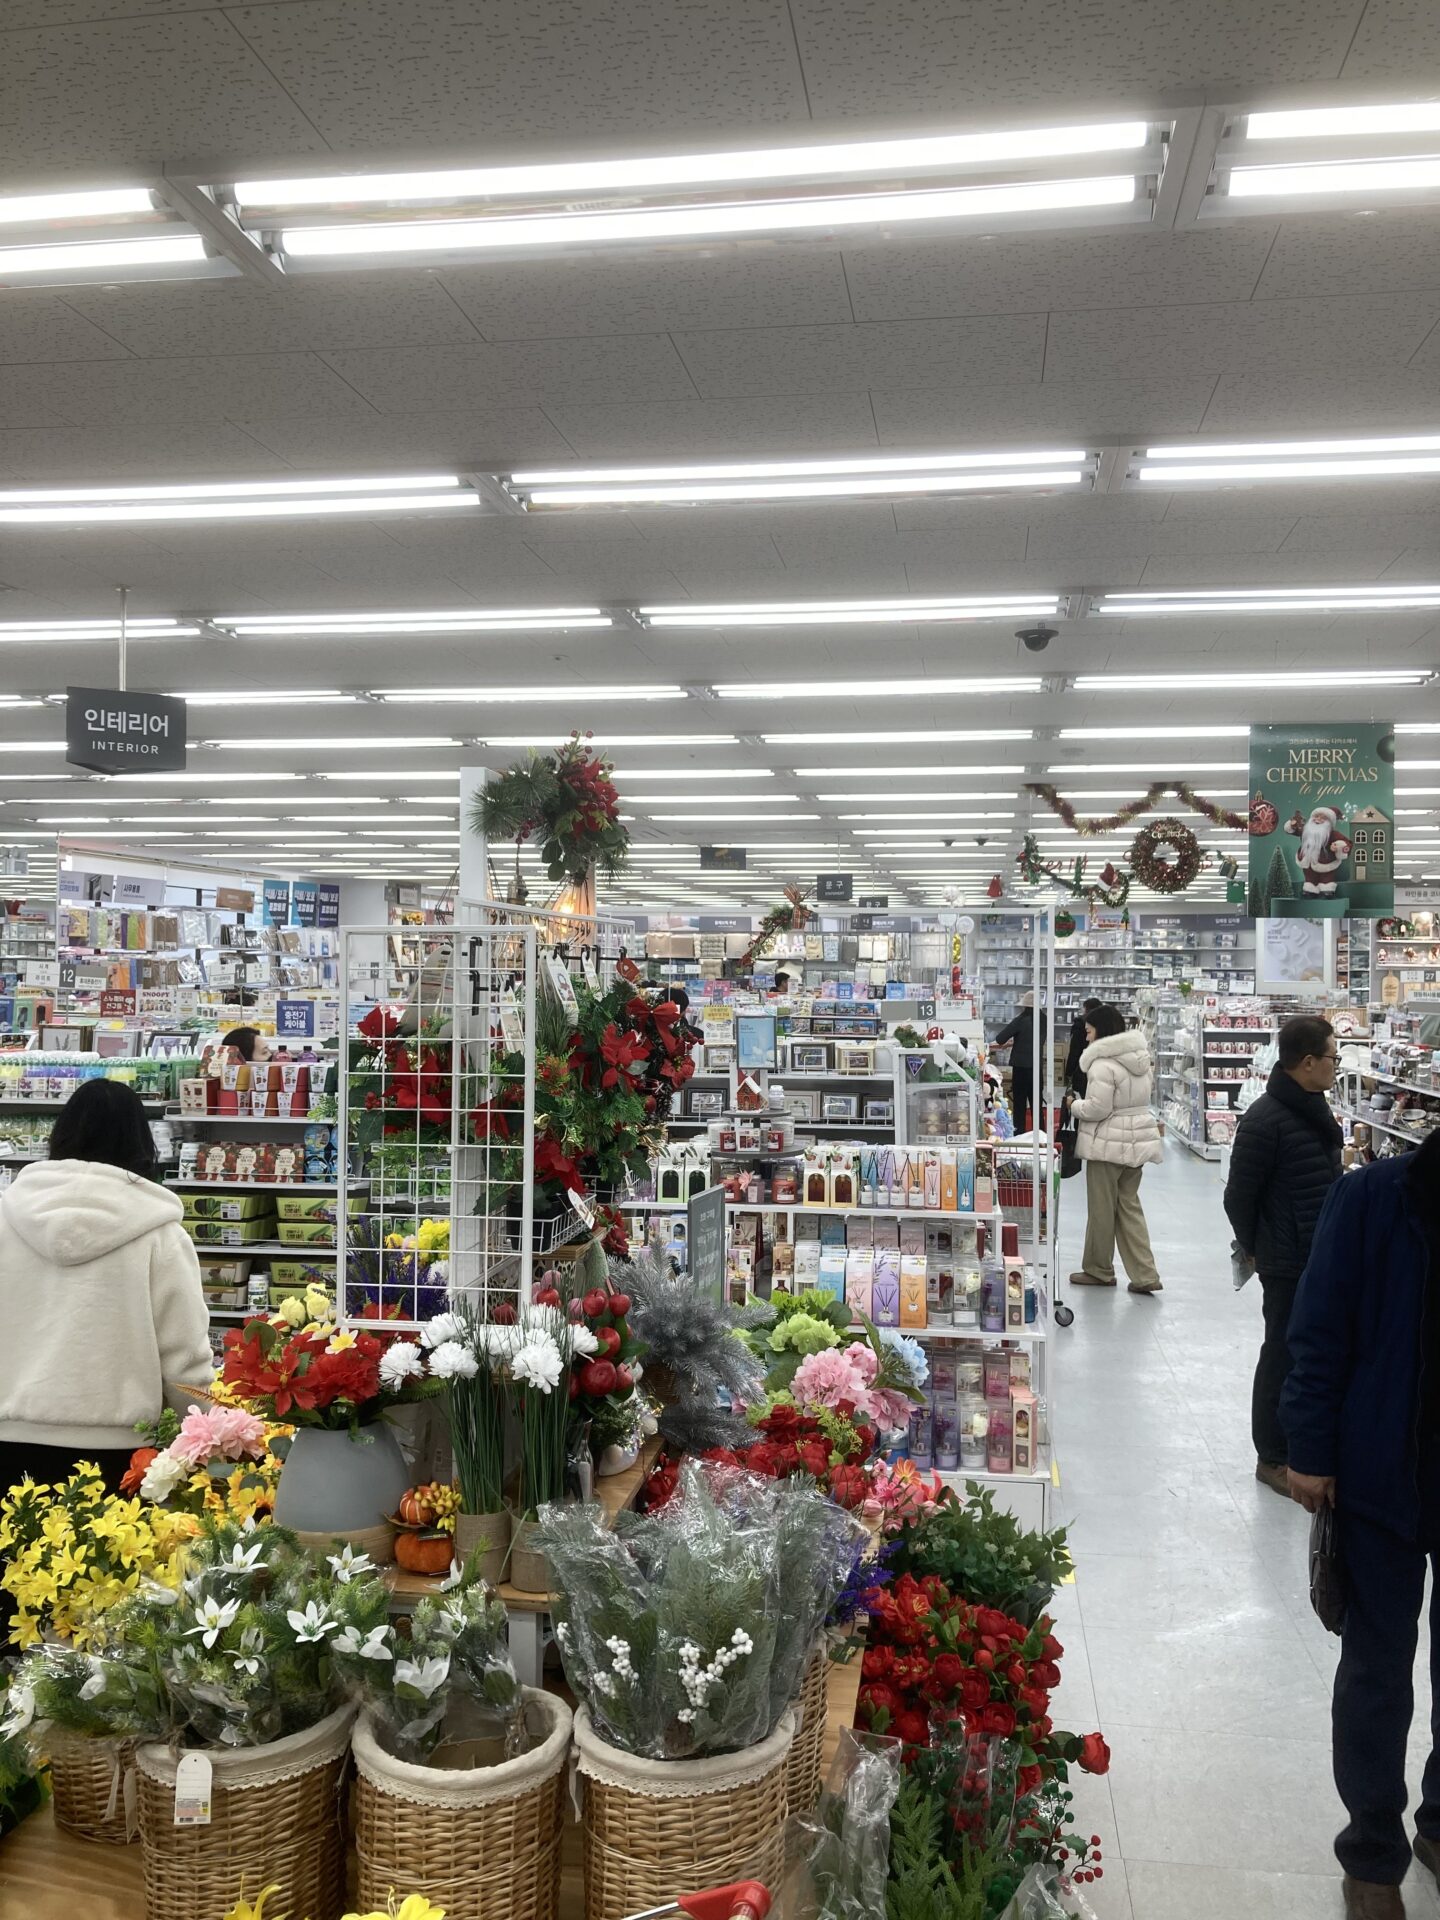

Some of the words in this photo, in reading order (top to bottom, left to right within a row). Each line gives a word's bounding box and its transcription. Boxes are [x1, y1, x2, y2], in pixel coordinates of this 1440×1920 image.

[84, 709, 169, 737] 인테리어
[92, 740, 159, 755] INTERIOR
[1288, 748, 1357, 764] MERRY
[1266, 767, 1378, 783] CHRISTMAS
[1299, 782, 1311, 795] to
[1313, 785, 1346, 803] you
[62, 969, 74, 983] 12
[236, 968, 245, 980] 14
[1219, 981, 1228, 990] 25
[284, 1010, 306, 1020] 충전기
[920, 1004, 934, 1017] 13
[284, 1019, 306, 1029] 케이블
